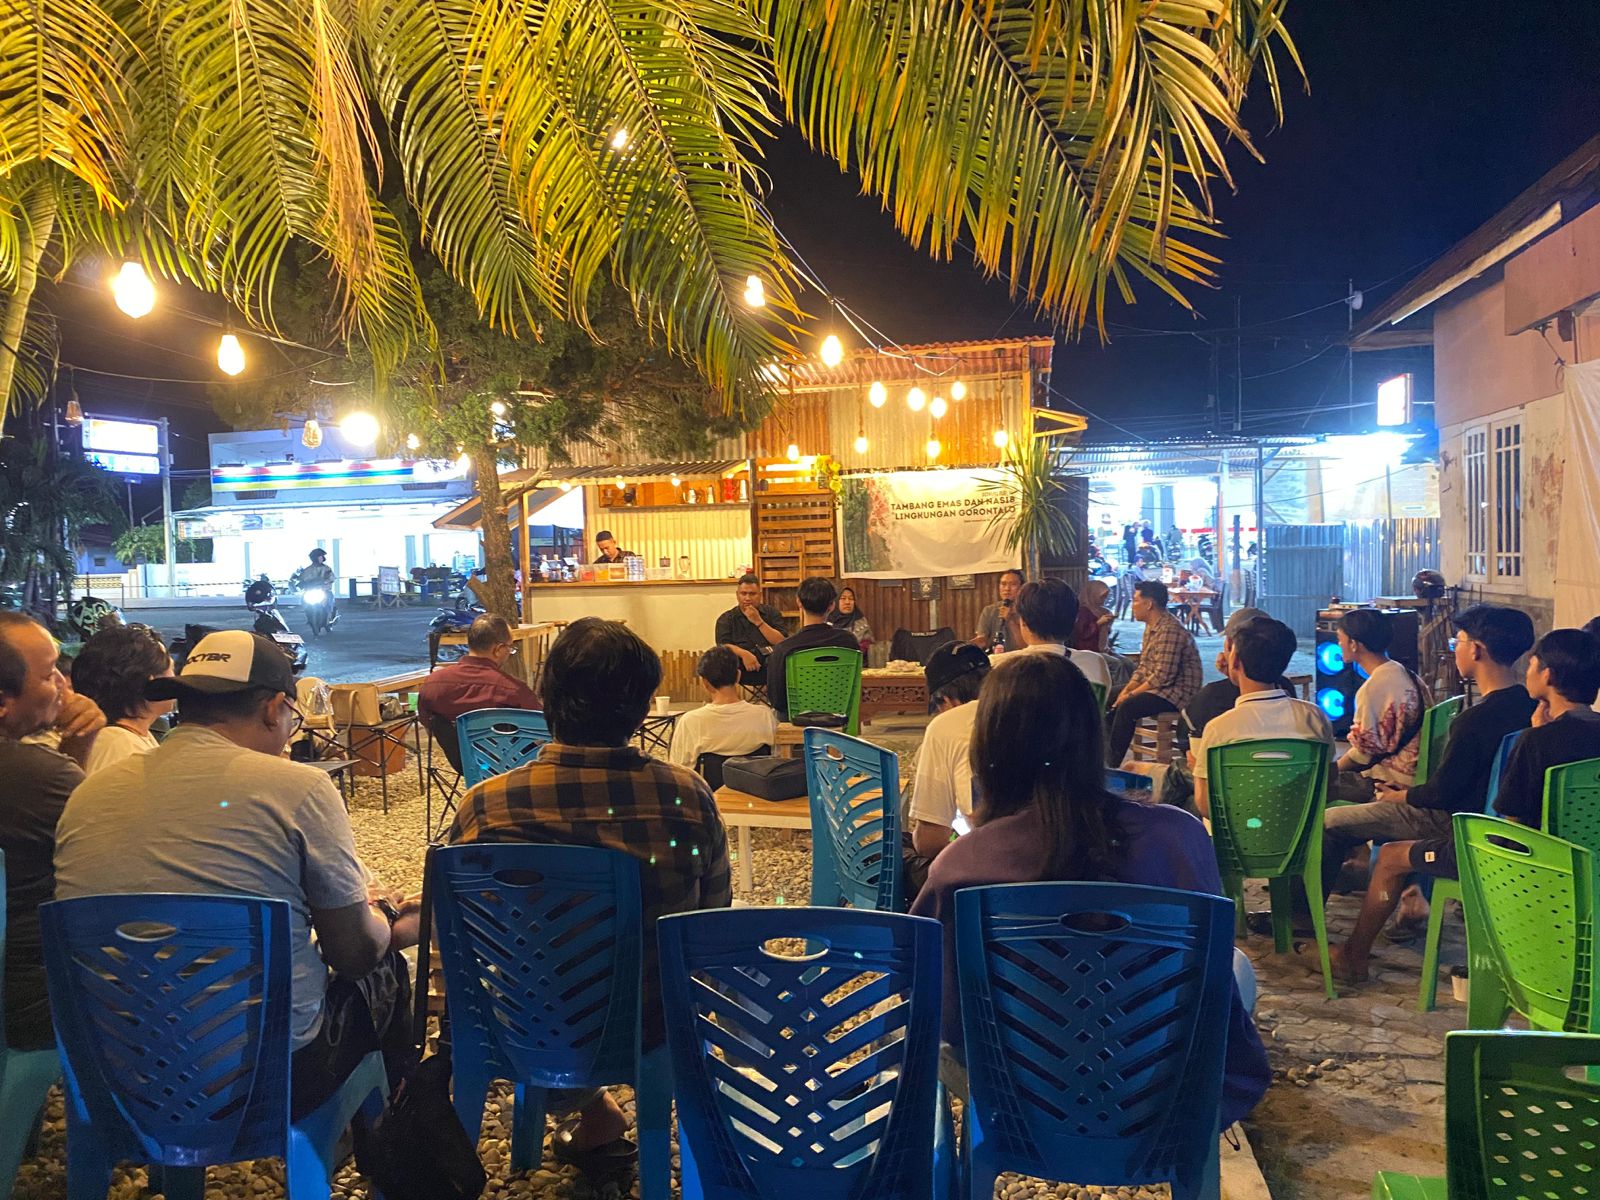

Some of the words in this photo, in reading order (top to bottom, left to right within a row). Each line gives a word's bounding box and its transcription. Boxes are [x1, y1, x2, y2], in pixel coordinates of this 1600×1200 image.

[891, 501, 934, 511] TAMBANG
[937, 499, 961, 508] EMAS
[964, 498, 984, 507] DAN
[895, 509, 956, 520] LINGKUNGAN
[959, 506, 1016, 516] GORONTALO
